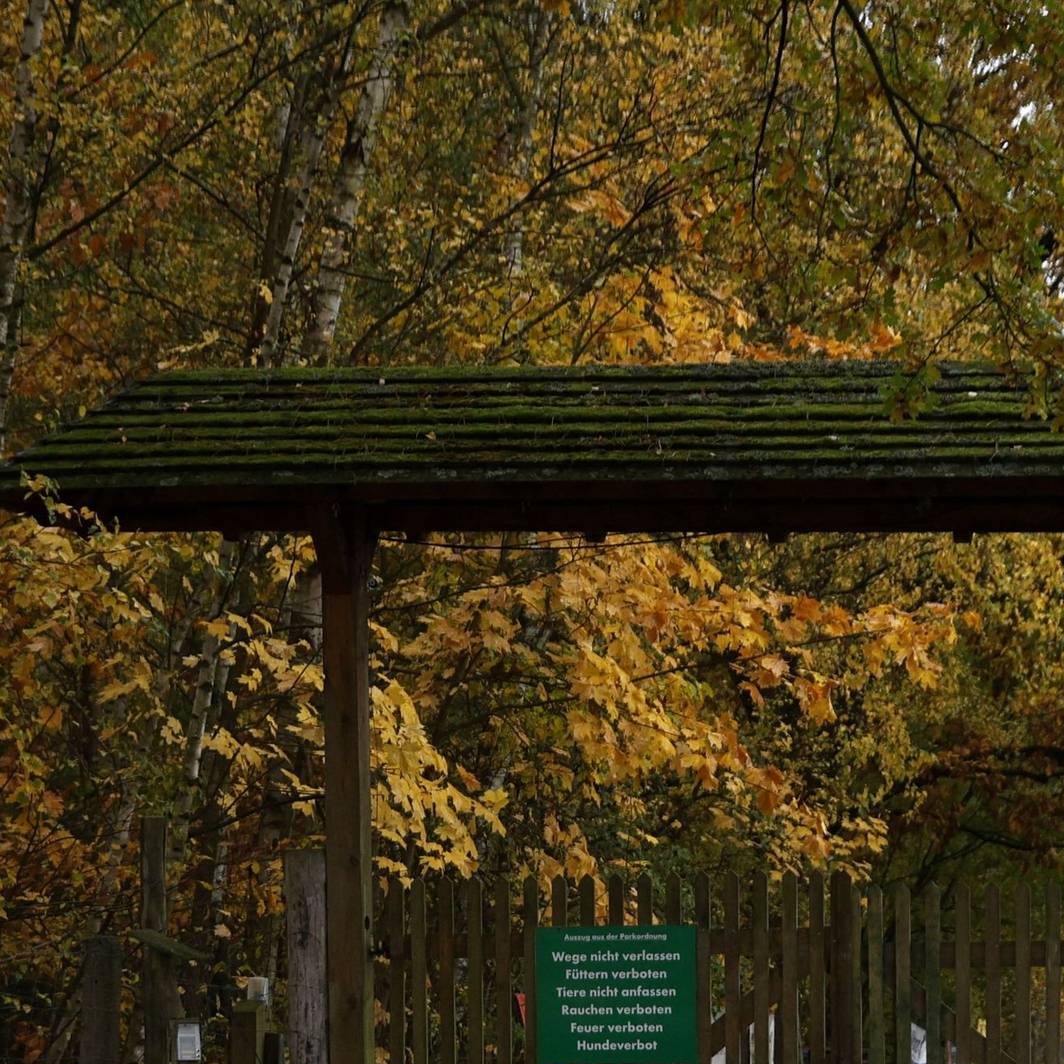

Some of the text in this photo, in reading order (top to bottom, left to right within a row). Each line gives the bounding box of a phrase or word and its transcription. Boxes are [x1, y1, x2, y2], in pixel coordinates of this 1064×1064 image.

[563, 934, 590, 942] Auszug
[620, 933, 667, 942] Parkordnung
[552, 950, 680, 964] Wege nicht verlassen
[565, 968, 667, 980] Füttern verboten
[556, 985, 676, 997] Tiere nicht anfassen
[561, 1003, 672, 1015] Rauchen verboten
[570, 1021, 663, 1033] Feuer verboten
[577, 1039, 658, 1051] Hundeverbot
